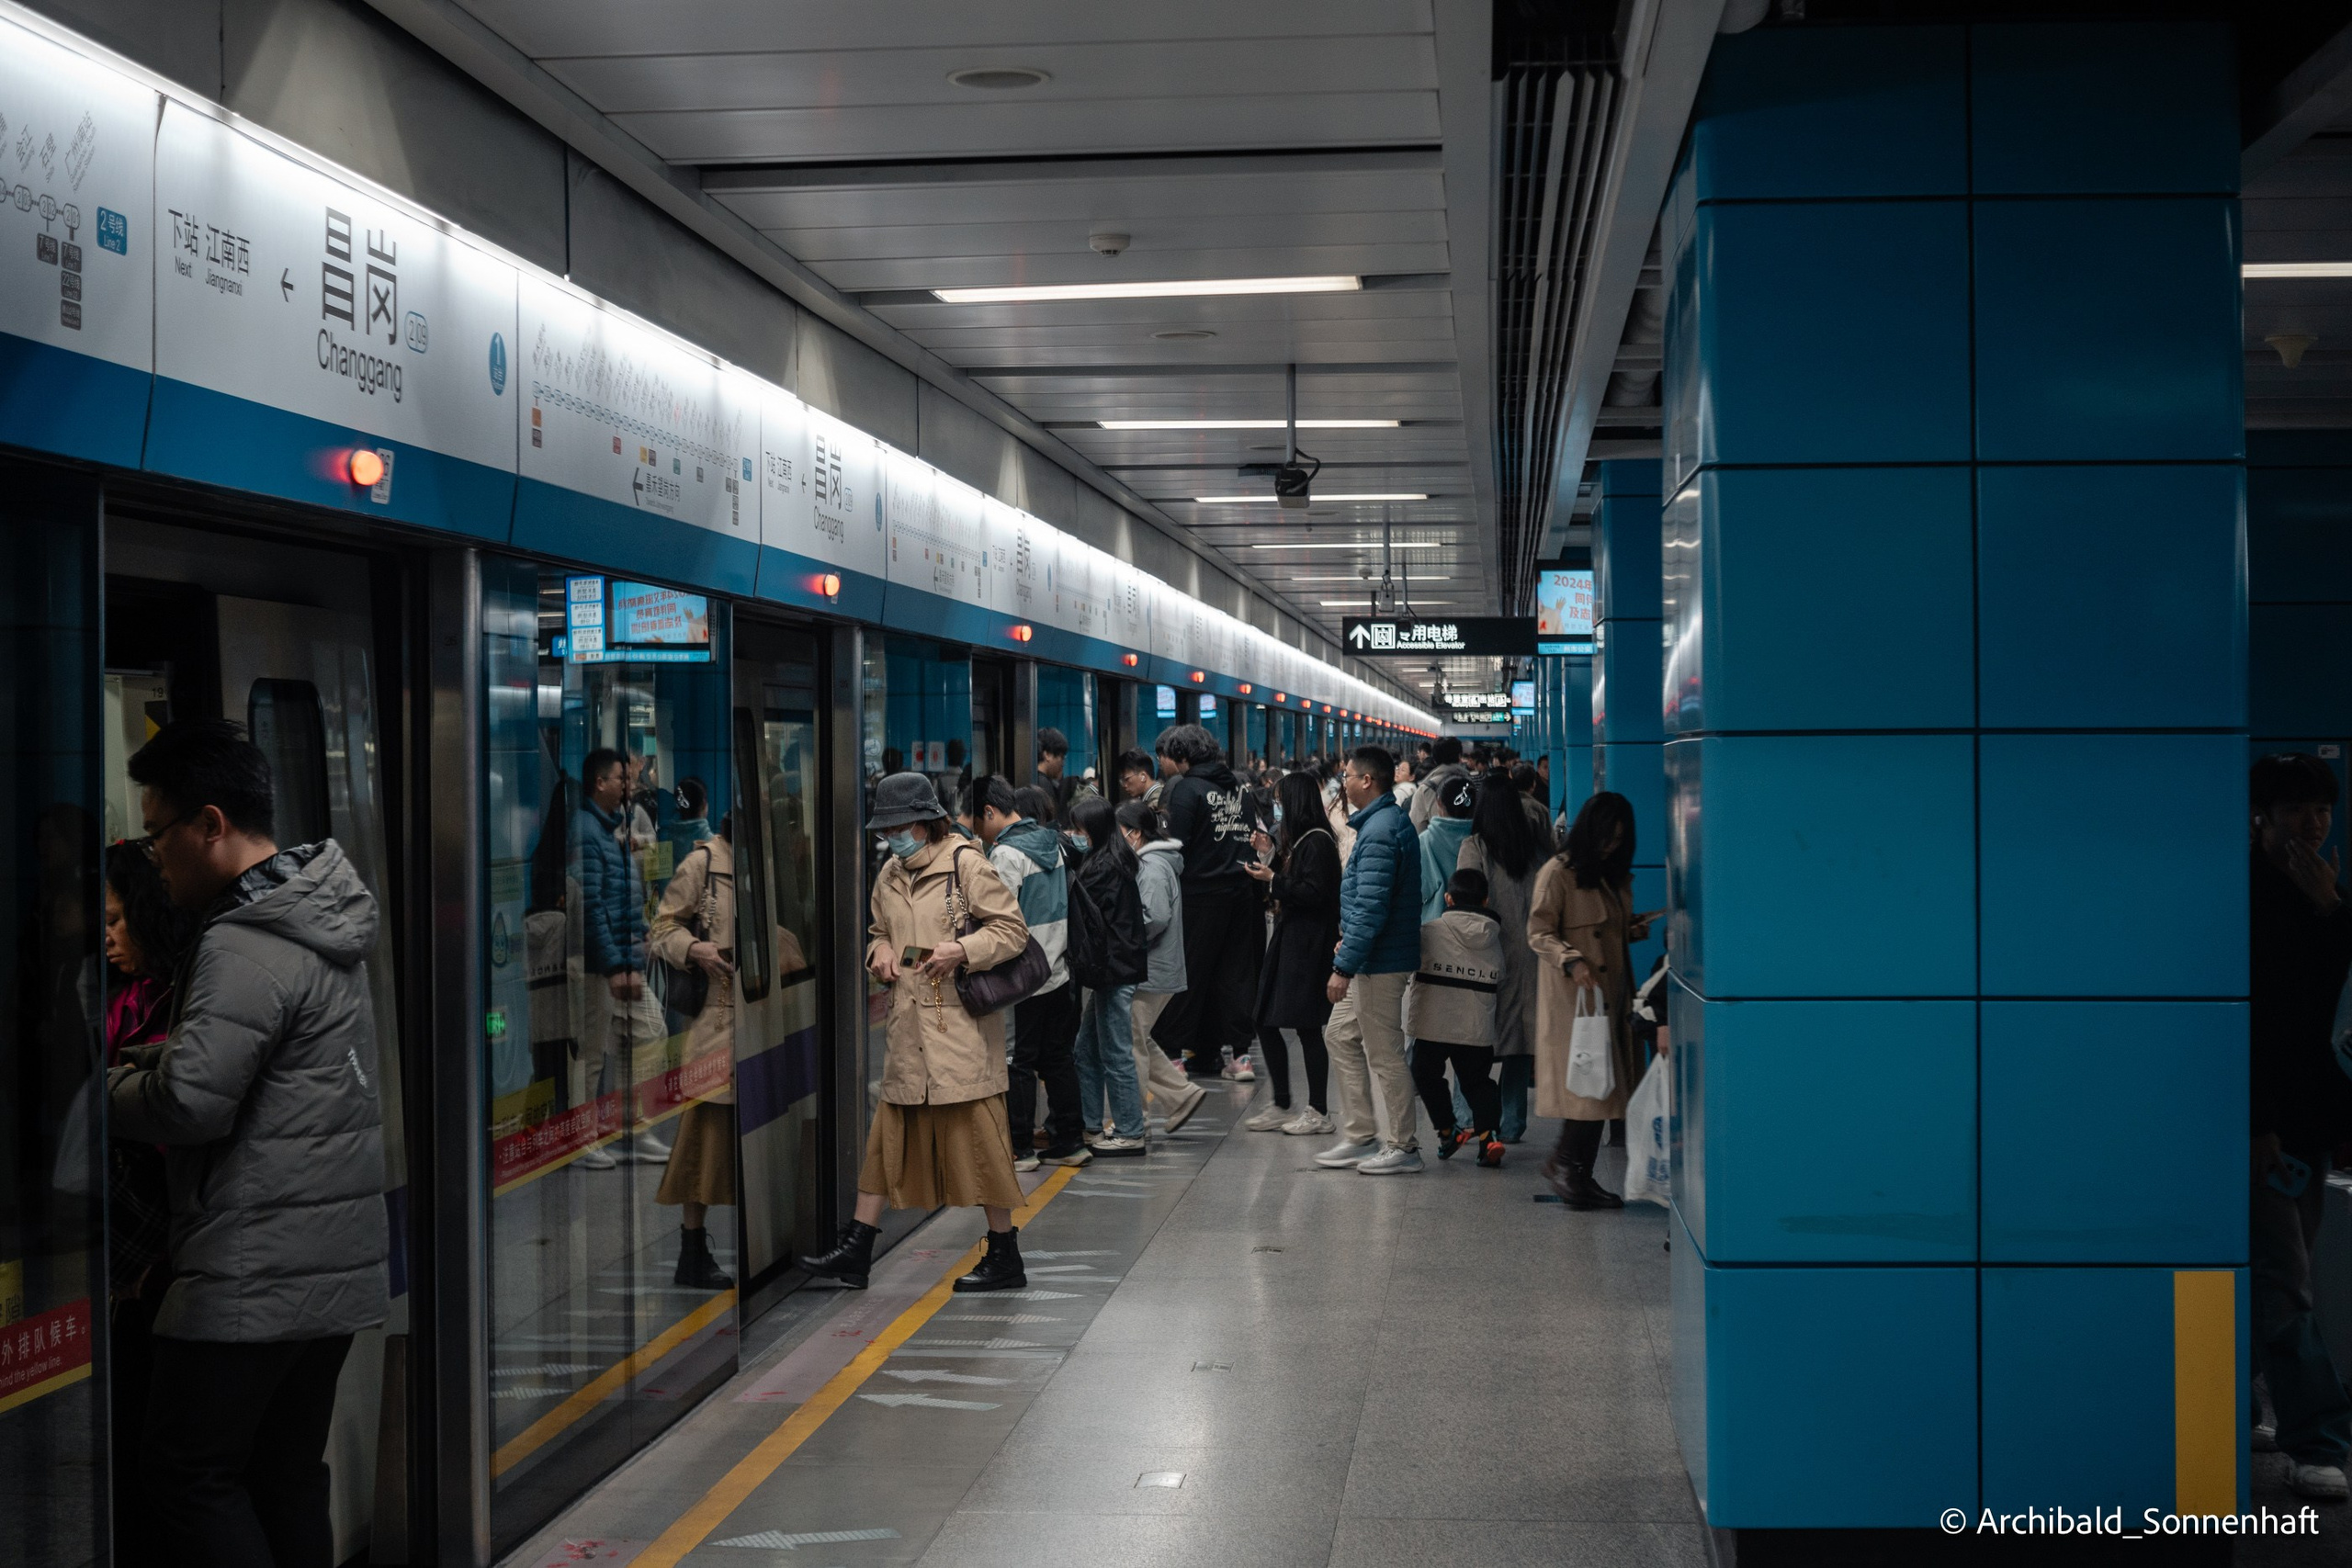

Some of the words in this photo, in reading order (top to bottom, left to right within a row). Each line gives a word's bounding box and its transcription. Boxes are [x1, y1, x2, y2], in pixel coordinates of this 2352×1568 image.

[99, 210, 124, 237] 2号线
[104, 234, 116, 250] Line
[116, 238, 121, 252] 2
[168, 208, 199, 257] 下站
[206, 222, 250, 276] 江南西
[175, 255, 192, 278] Next
[205, 267, 243, 297] Jiangnanxi
[322, 206, 397, 345] 昌岗
[317, 327, 402, 404] Changgang
[815, 434, 842, 510] 昌岗
[1554, 574, 1593, 592] 2024年
[1396, 640, 1434, 650] Accessible
[1435, 641, 1466, 650] Elevator
[152, 686, 164, 698] 19
[1, 1315, 85, 1366] 外排队候车。
[14, 1369, 26, 1383] the
[26, 1361, 48, 1382] yellow
[48, 1355, 62, 1370] line.
